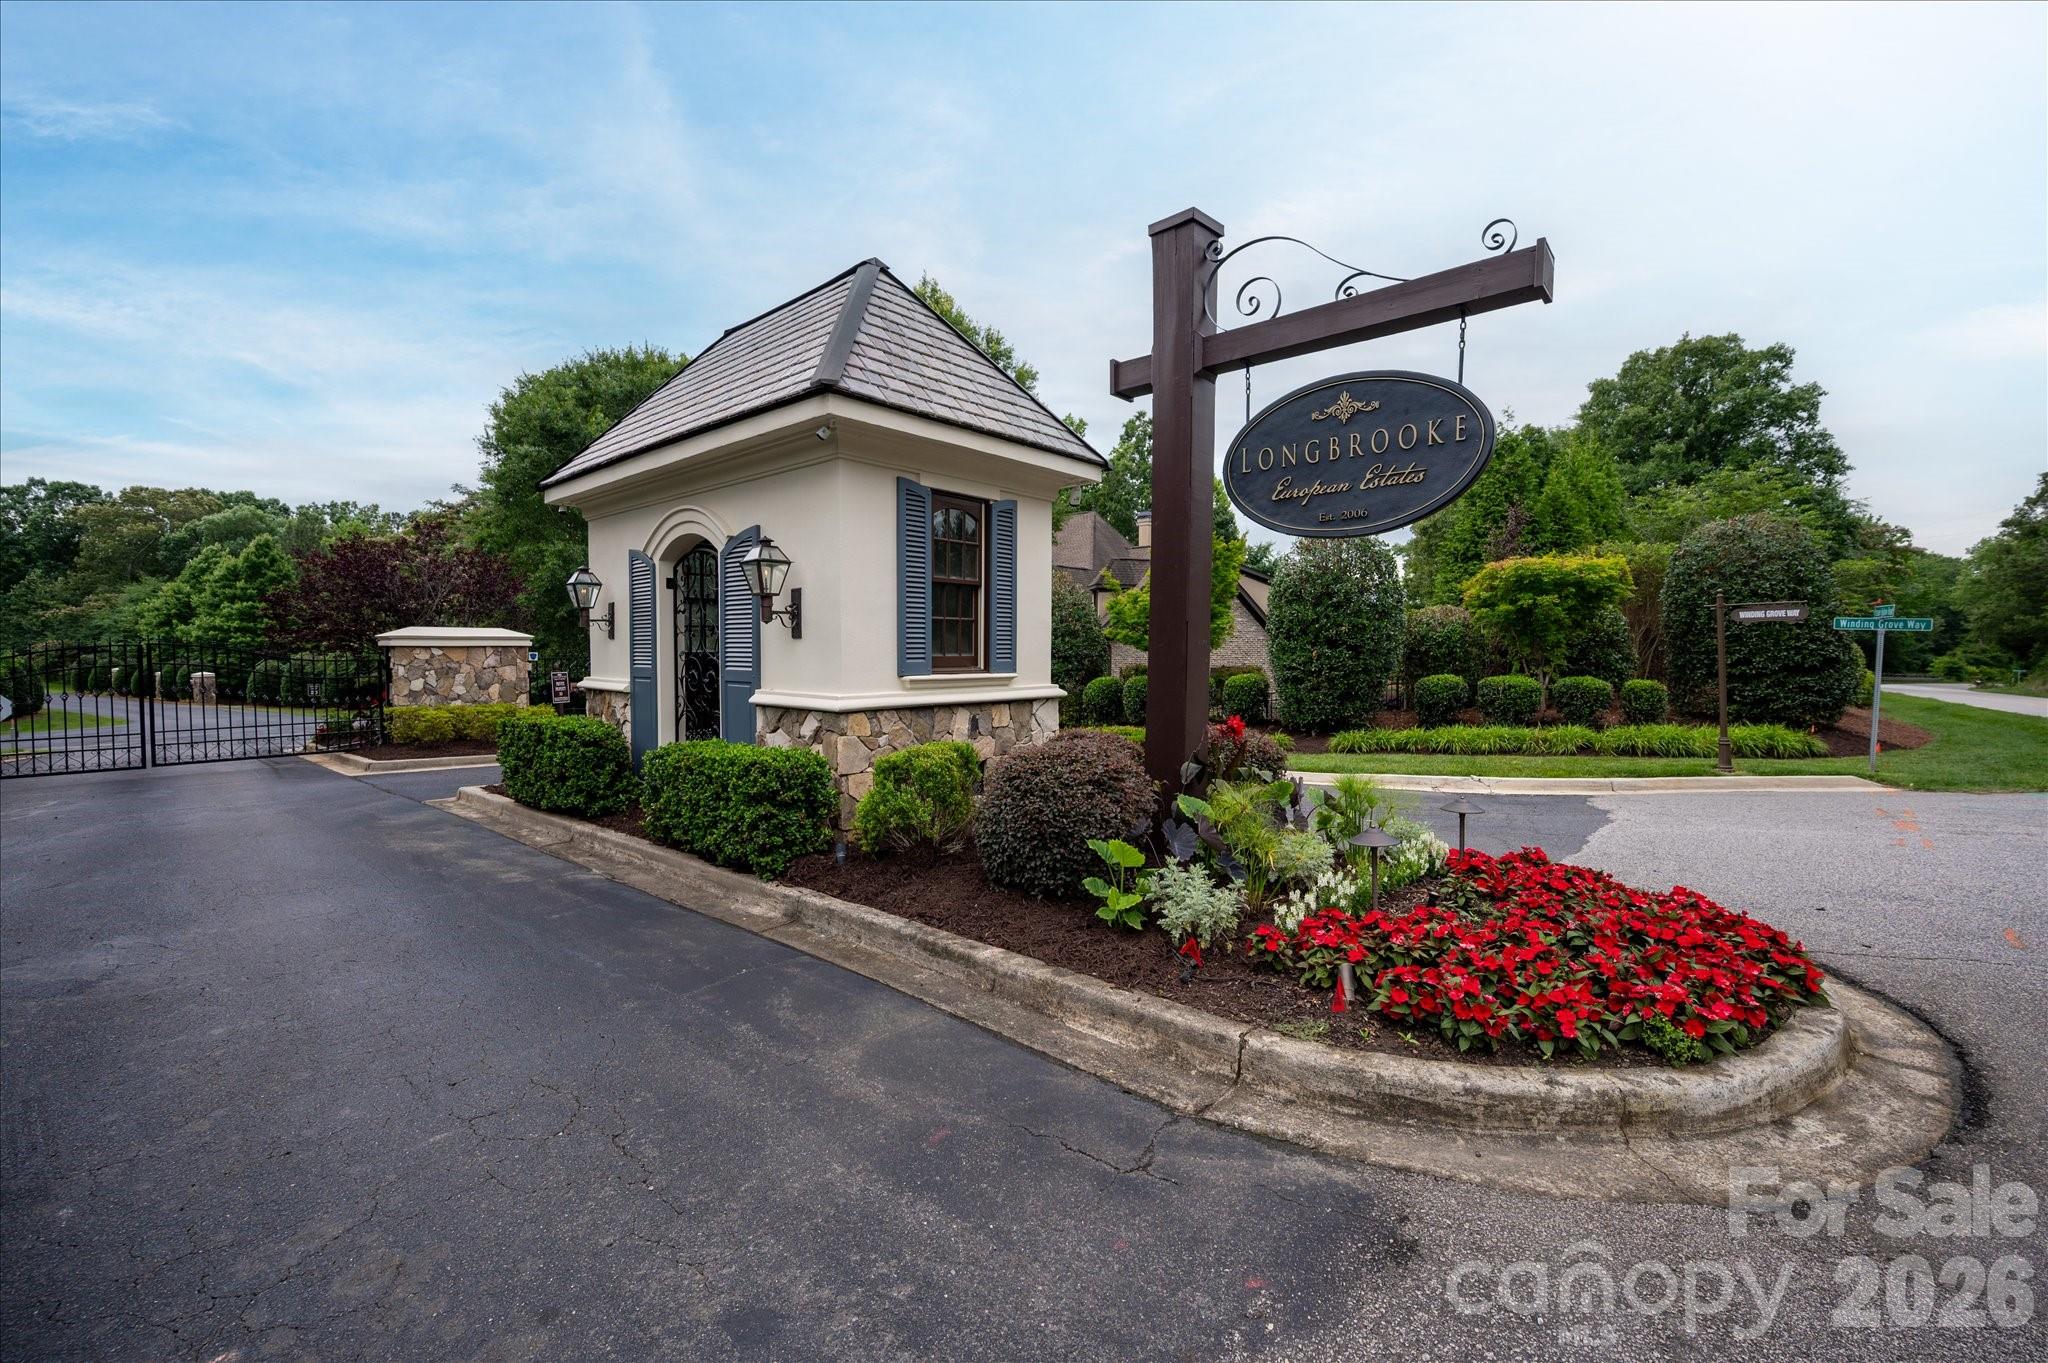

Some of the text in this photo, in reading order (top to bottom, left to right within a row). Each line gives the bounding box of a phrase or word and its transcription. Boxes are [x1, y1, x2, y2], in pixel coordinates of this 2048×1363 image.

[1242, 415, 1466, 473] LONGBROOKE
[1272, 462, 1428, 506] European Estates
[1319, 508, 1368, 523] Est. 2006
[1739, 609, 1800, 618] WINDING GROVE WAY
[1840, 619, 1926, 630] Winding Grove Way
